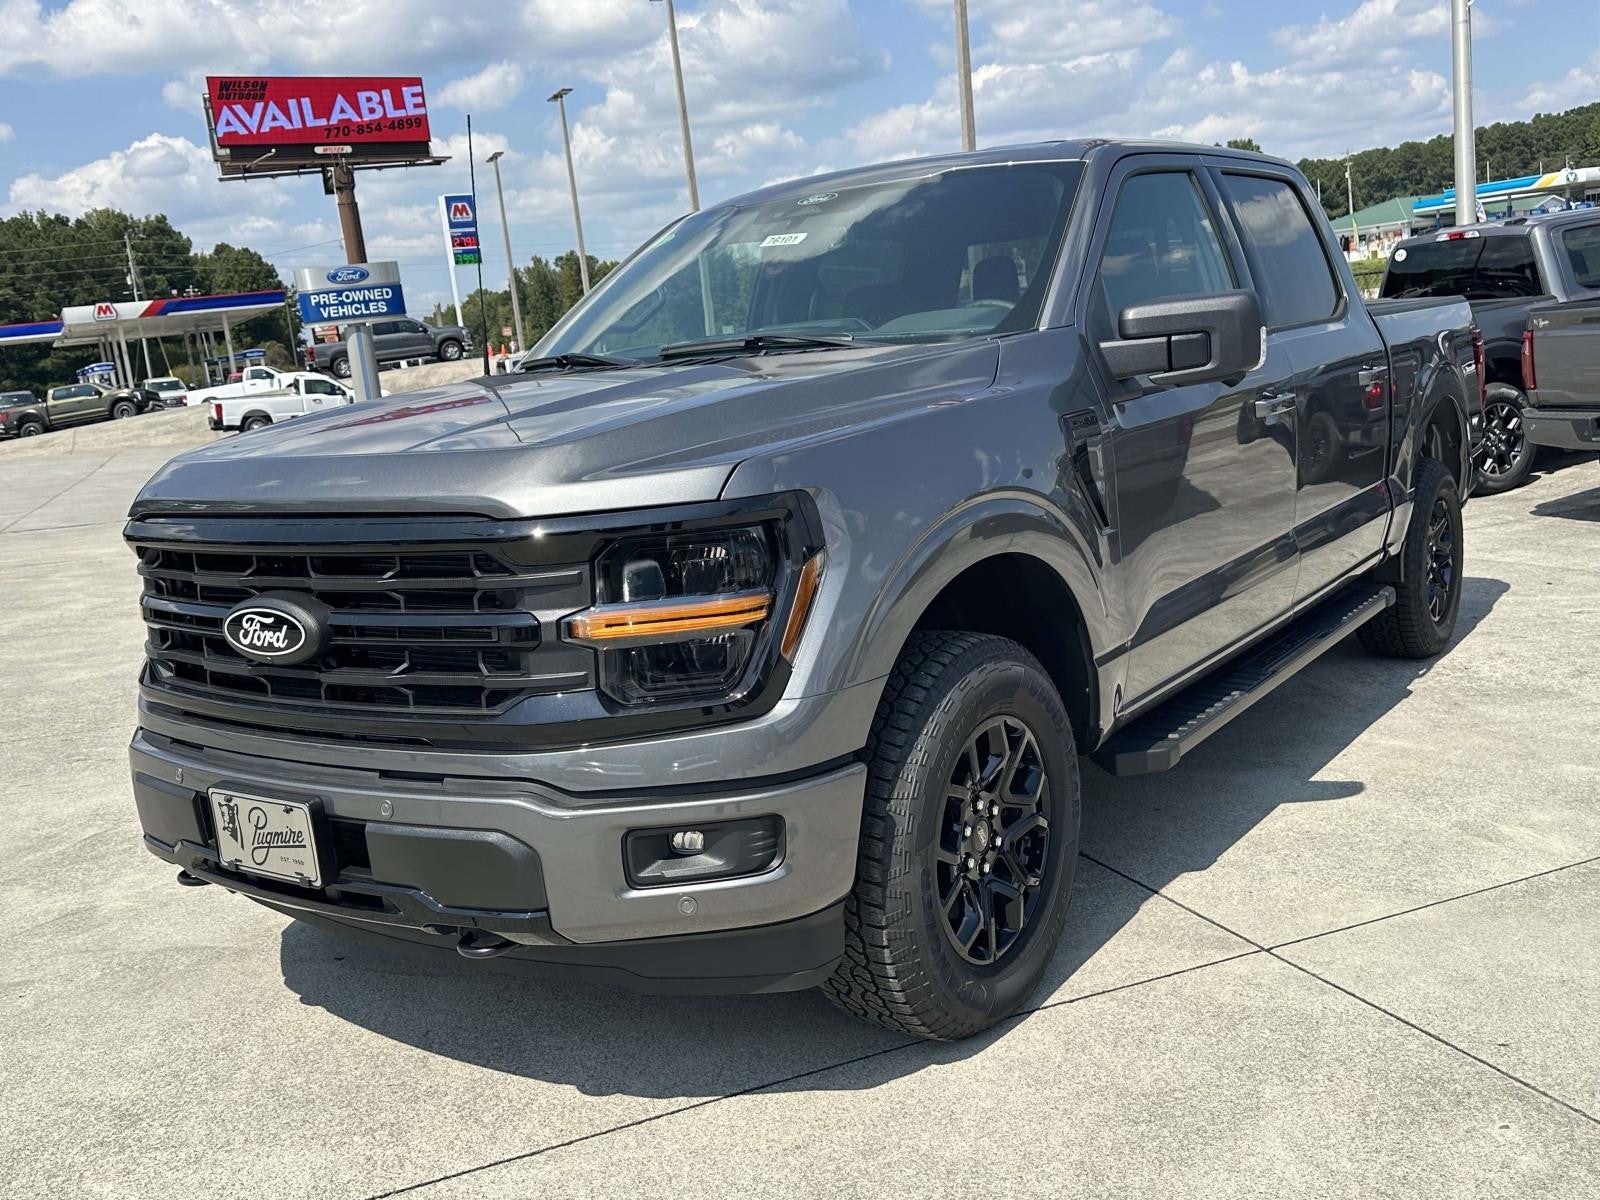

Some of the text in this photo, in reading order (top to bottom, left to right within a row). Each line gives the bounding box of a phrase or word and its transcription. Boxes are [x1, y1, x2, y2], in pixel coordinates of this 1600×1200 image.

[218, 80, 268, 92] WILSON
[217, 92, 265, 100] OUTDOOR
[216, 86, 425, 137] AVAILABLE
[324, 117, 422, 139] 770-854-4899
[767, 236, 799, 245] 76101
[336, 270, 361, 281] Ford
[311, 288, 392, 306] PRE-OWNED
[320, 301, 388, 318] VEHICLES
[239, 613, 289, 649] Ford
[248, 806, 306, 866] Pugmire
